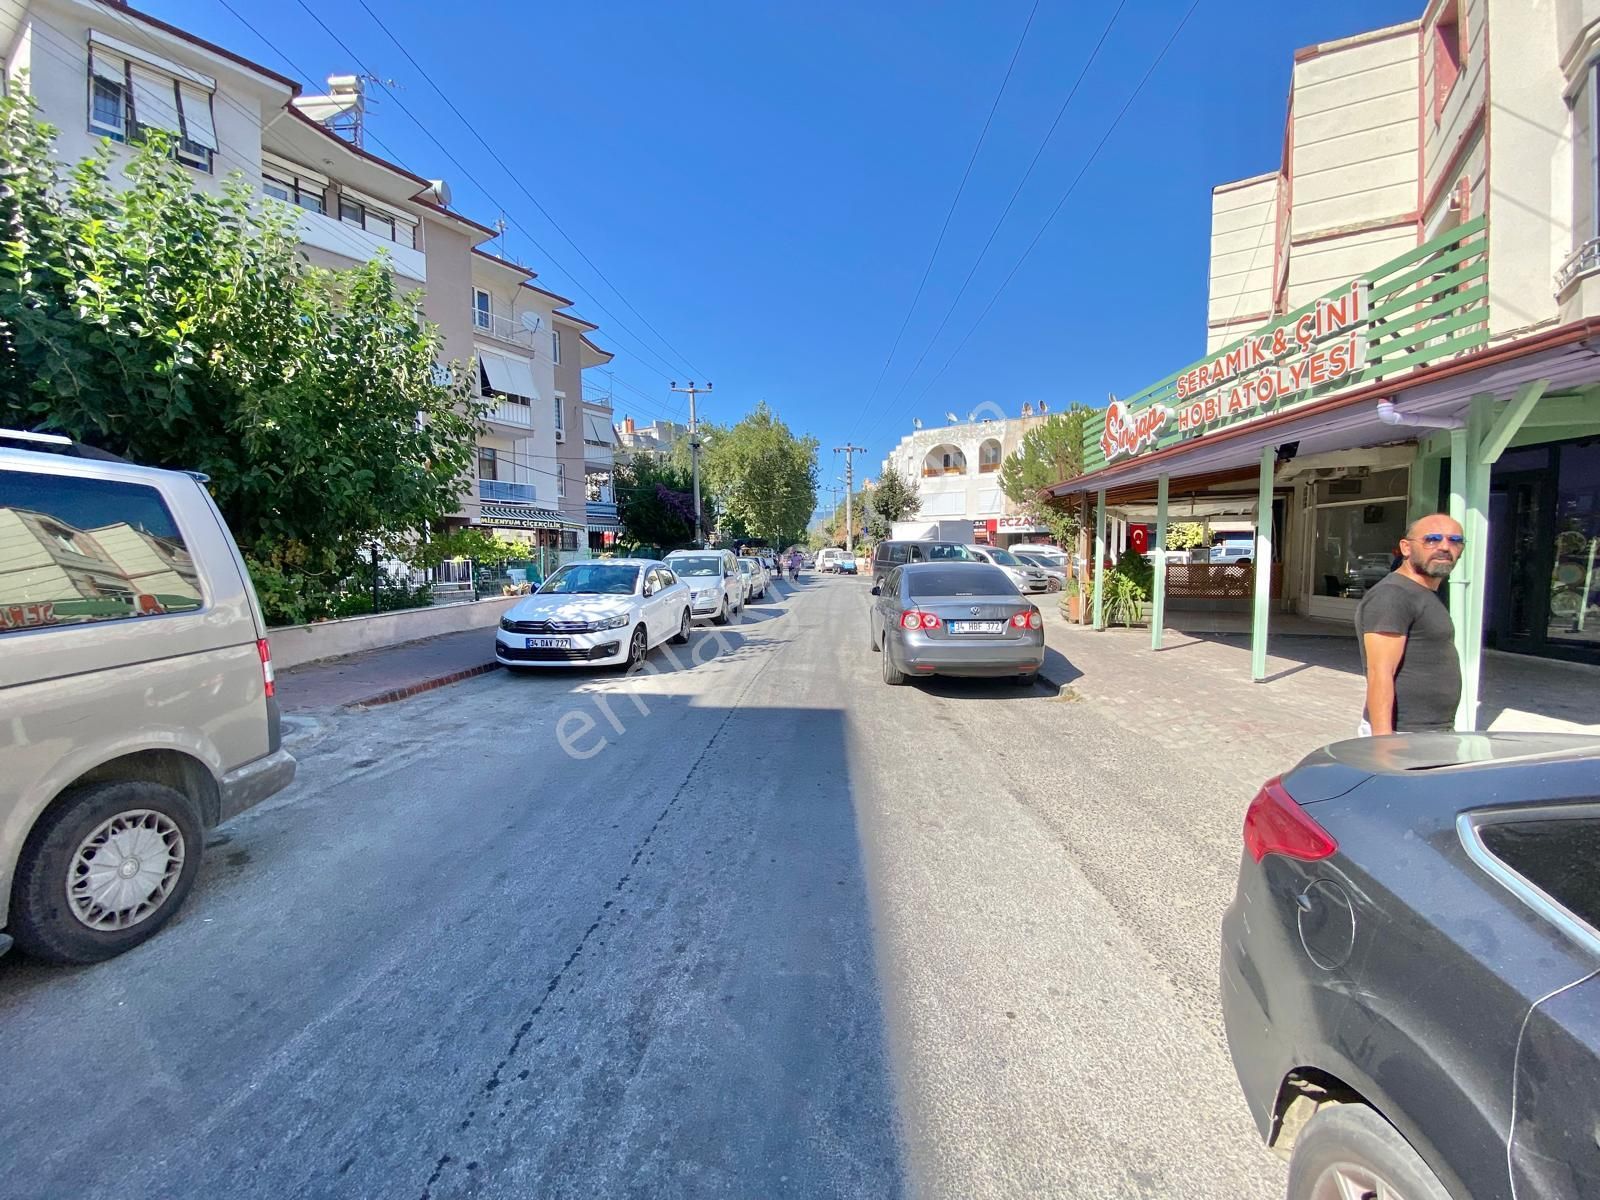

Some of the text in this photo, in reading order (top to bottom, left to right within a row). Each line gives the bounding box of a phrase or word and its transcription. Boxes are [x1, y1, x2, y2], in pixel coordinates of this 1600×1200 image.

[1176, 280, 1360, 399] SERAMİK & ÇİNİ
[1178, 331, 1357, 432] HOBİ ATÖLYESİ
[480, 516, 521, 526] MİLENYUM
[956, 621, 964, 631] 34
[530, 639, 538, 647] 34
